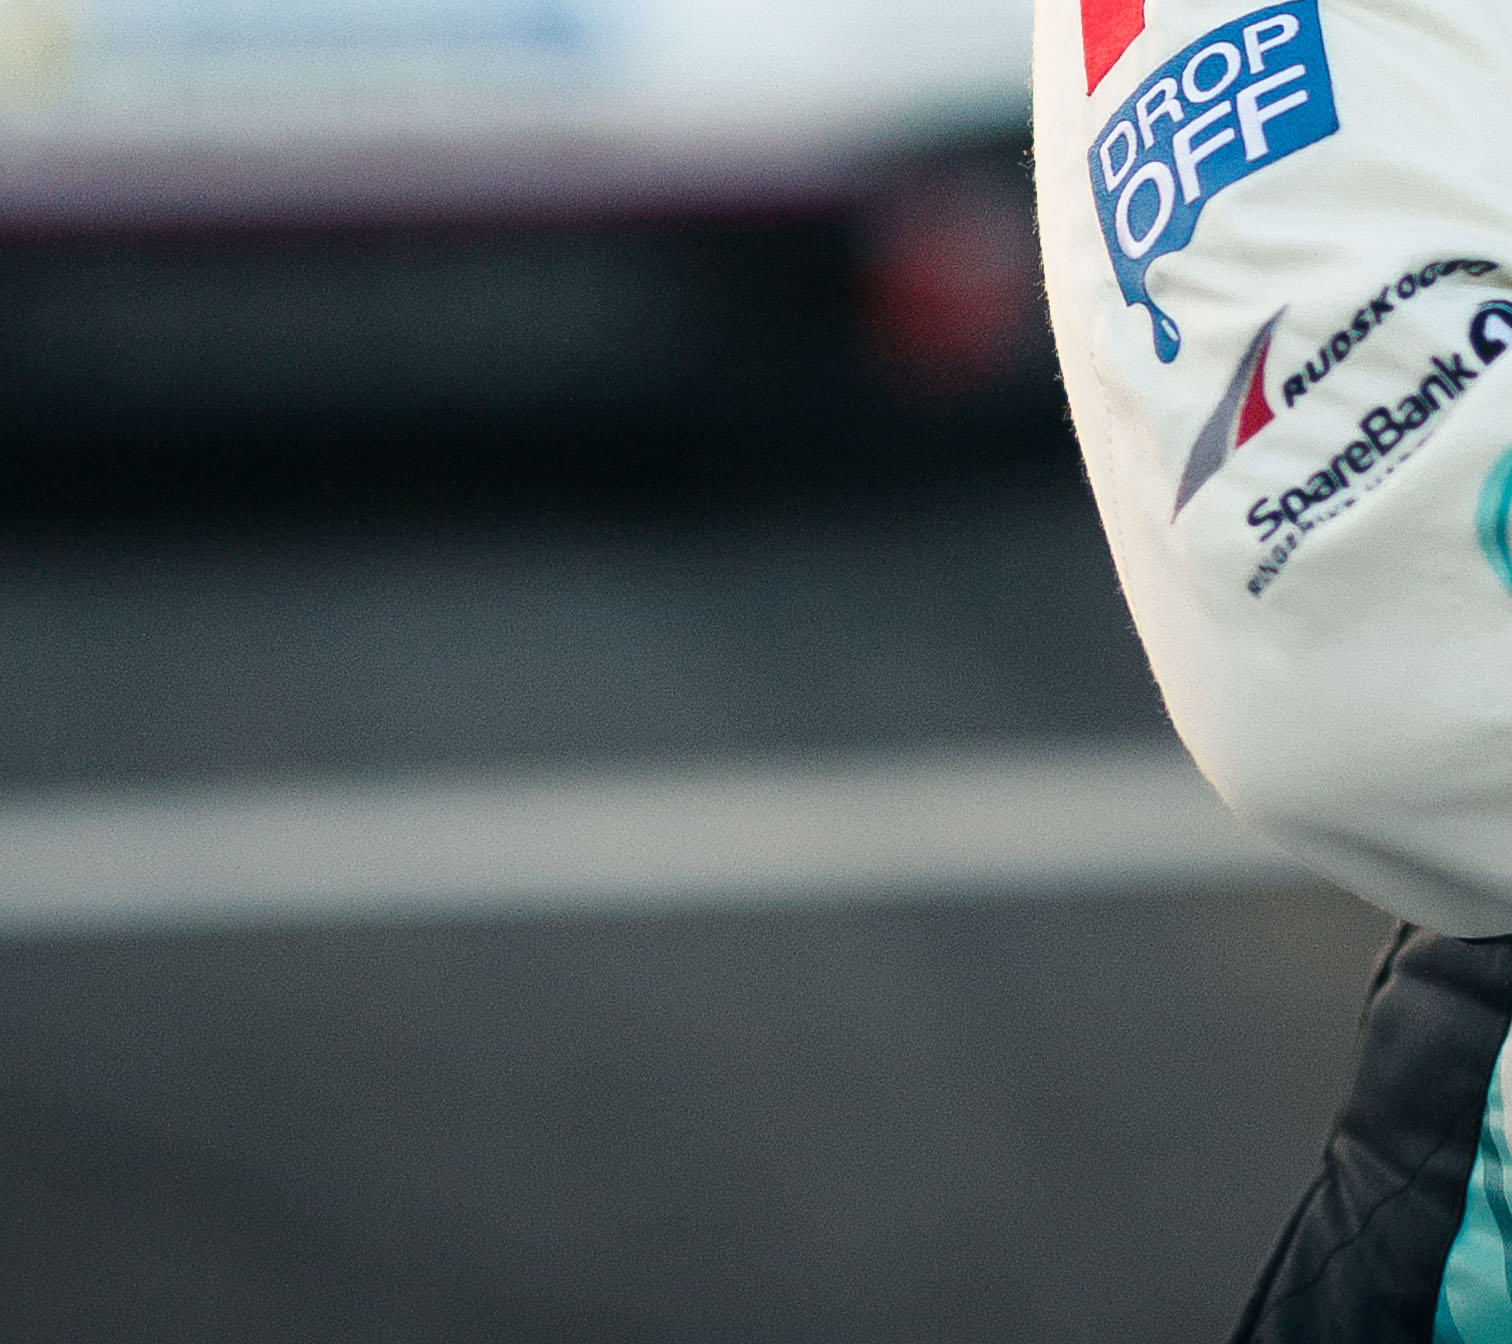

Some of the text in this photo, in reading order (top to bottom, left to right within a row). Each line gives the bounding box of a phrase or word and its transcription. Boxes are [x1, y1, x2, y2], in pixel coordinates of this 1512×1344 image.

[1099, 14, 1300, 193] DROP
[1114, 64, 1310, 260] OFF
[1247, 352, 1479, 543] SpareBank
